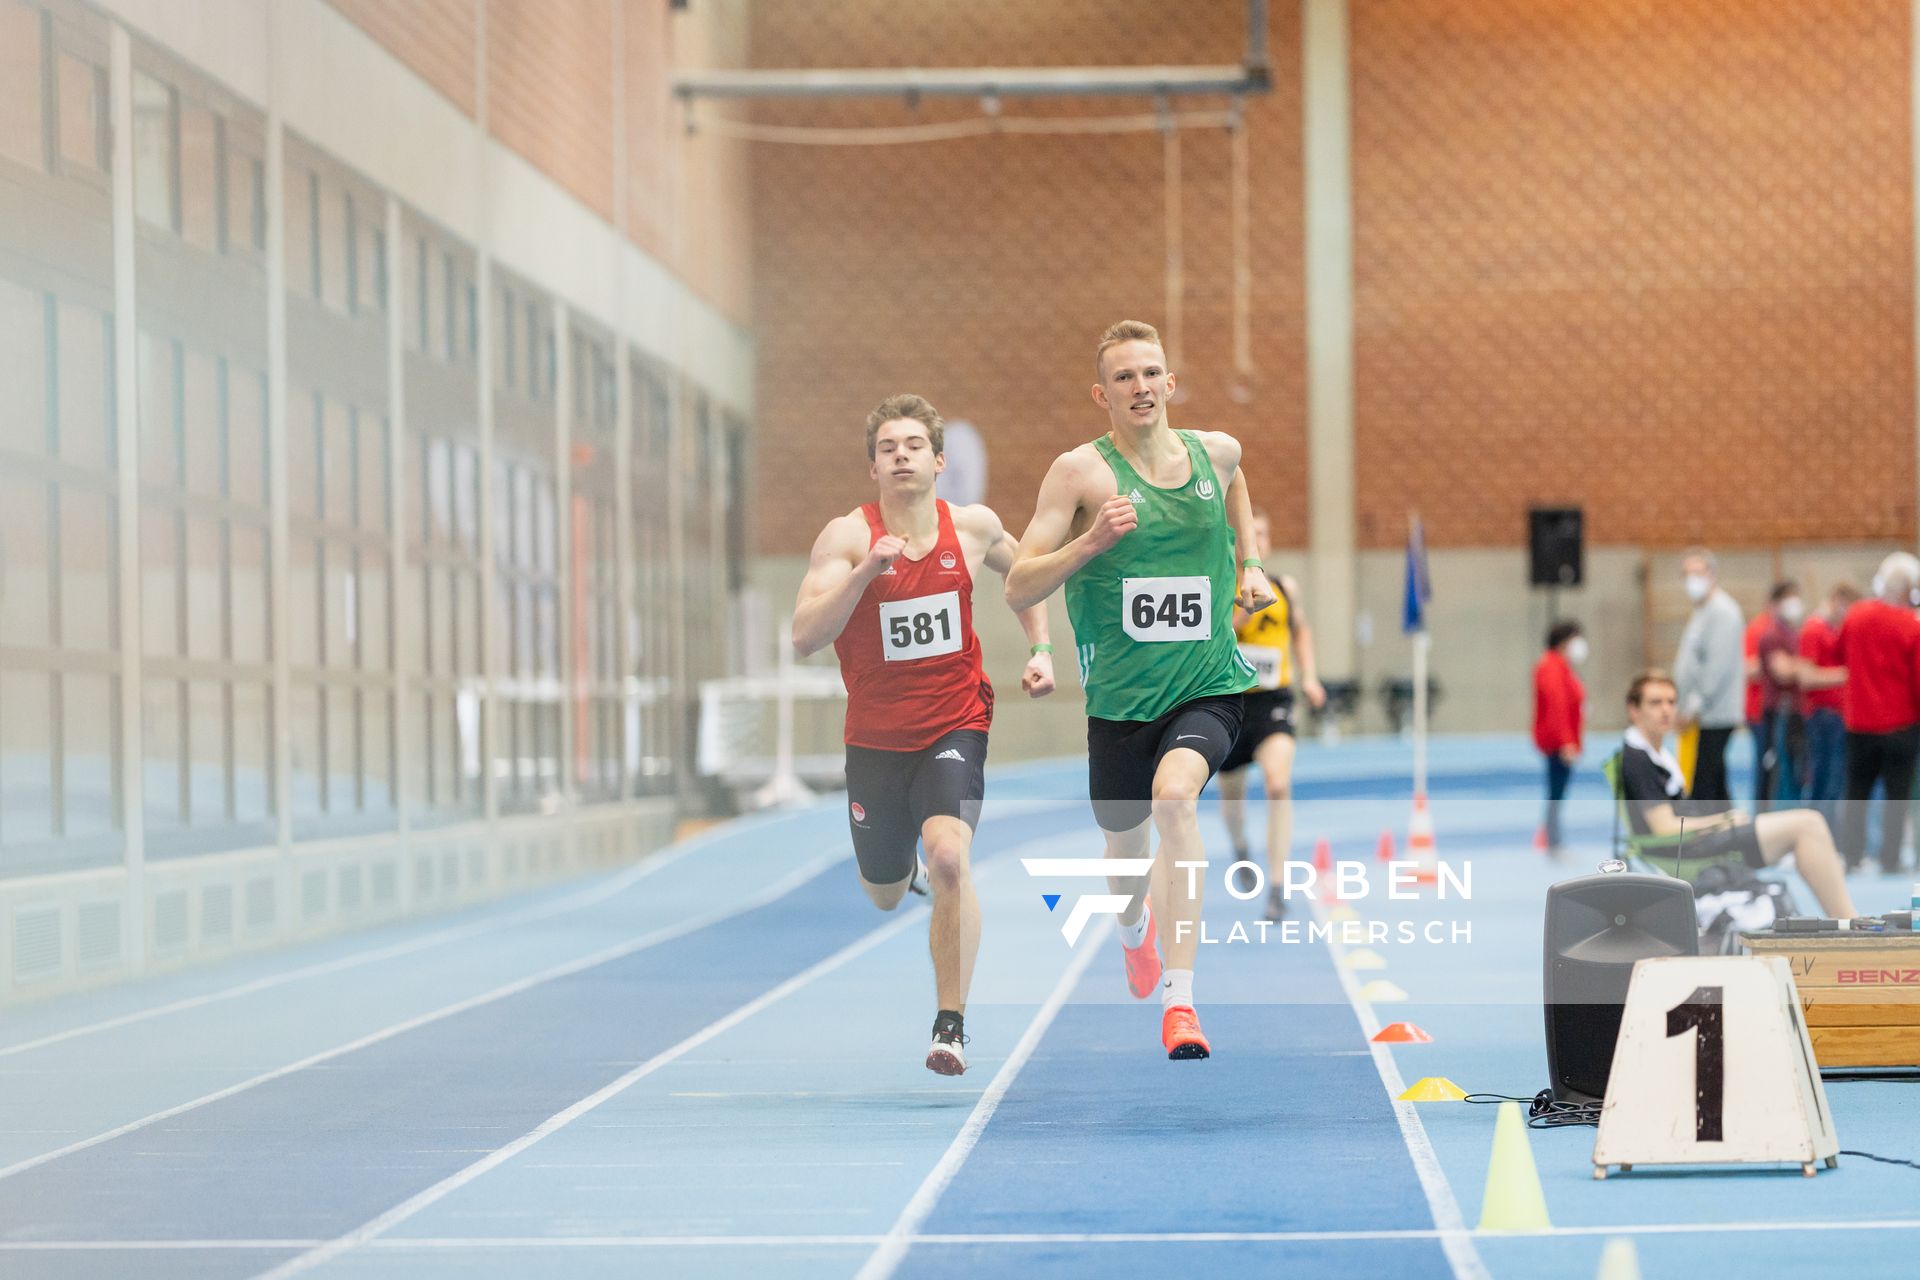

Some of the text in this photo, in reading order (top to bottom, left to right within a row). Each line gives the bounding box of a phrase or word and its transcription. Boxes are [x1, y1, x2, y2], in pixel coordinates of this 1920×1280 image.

[889, 608, 951, 648] 581
[1131, 593, 1203, 628] 645
[1837, 969, 1920, 983] BENZ
[1666, 986, 1723, 1142] 1
